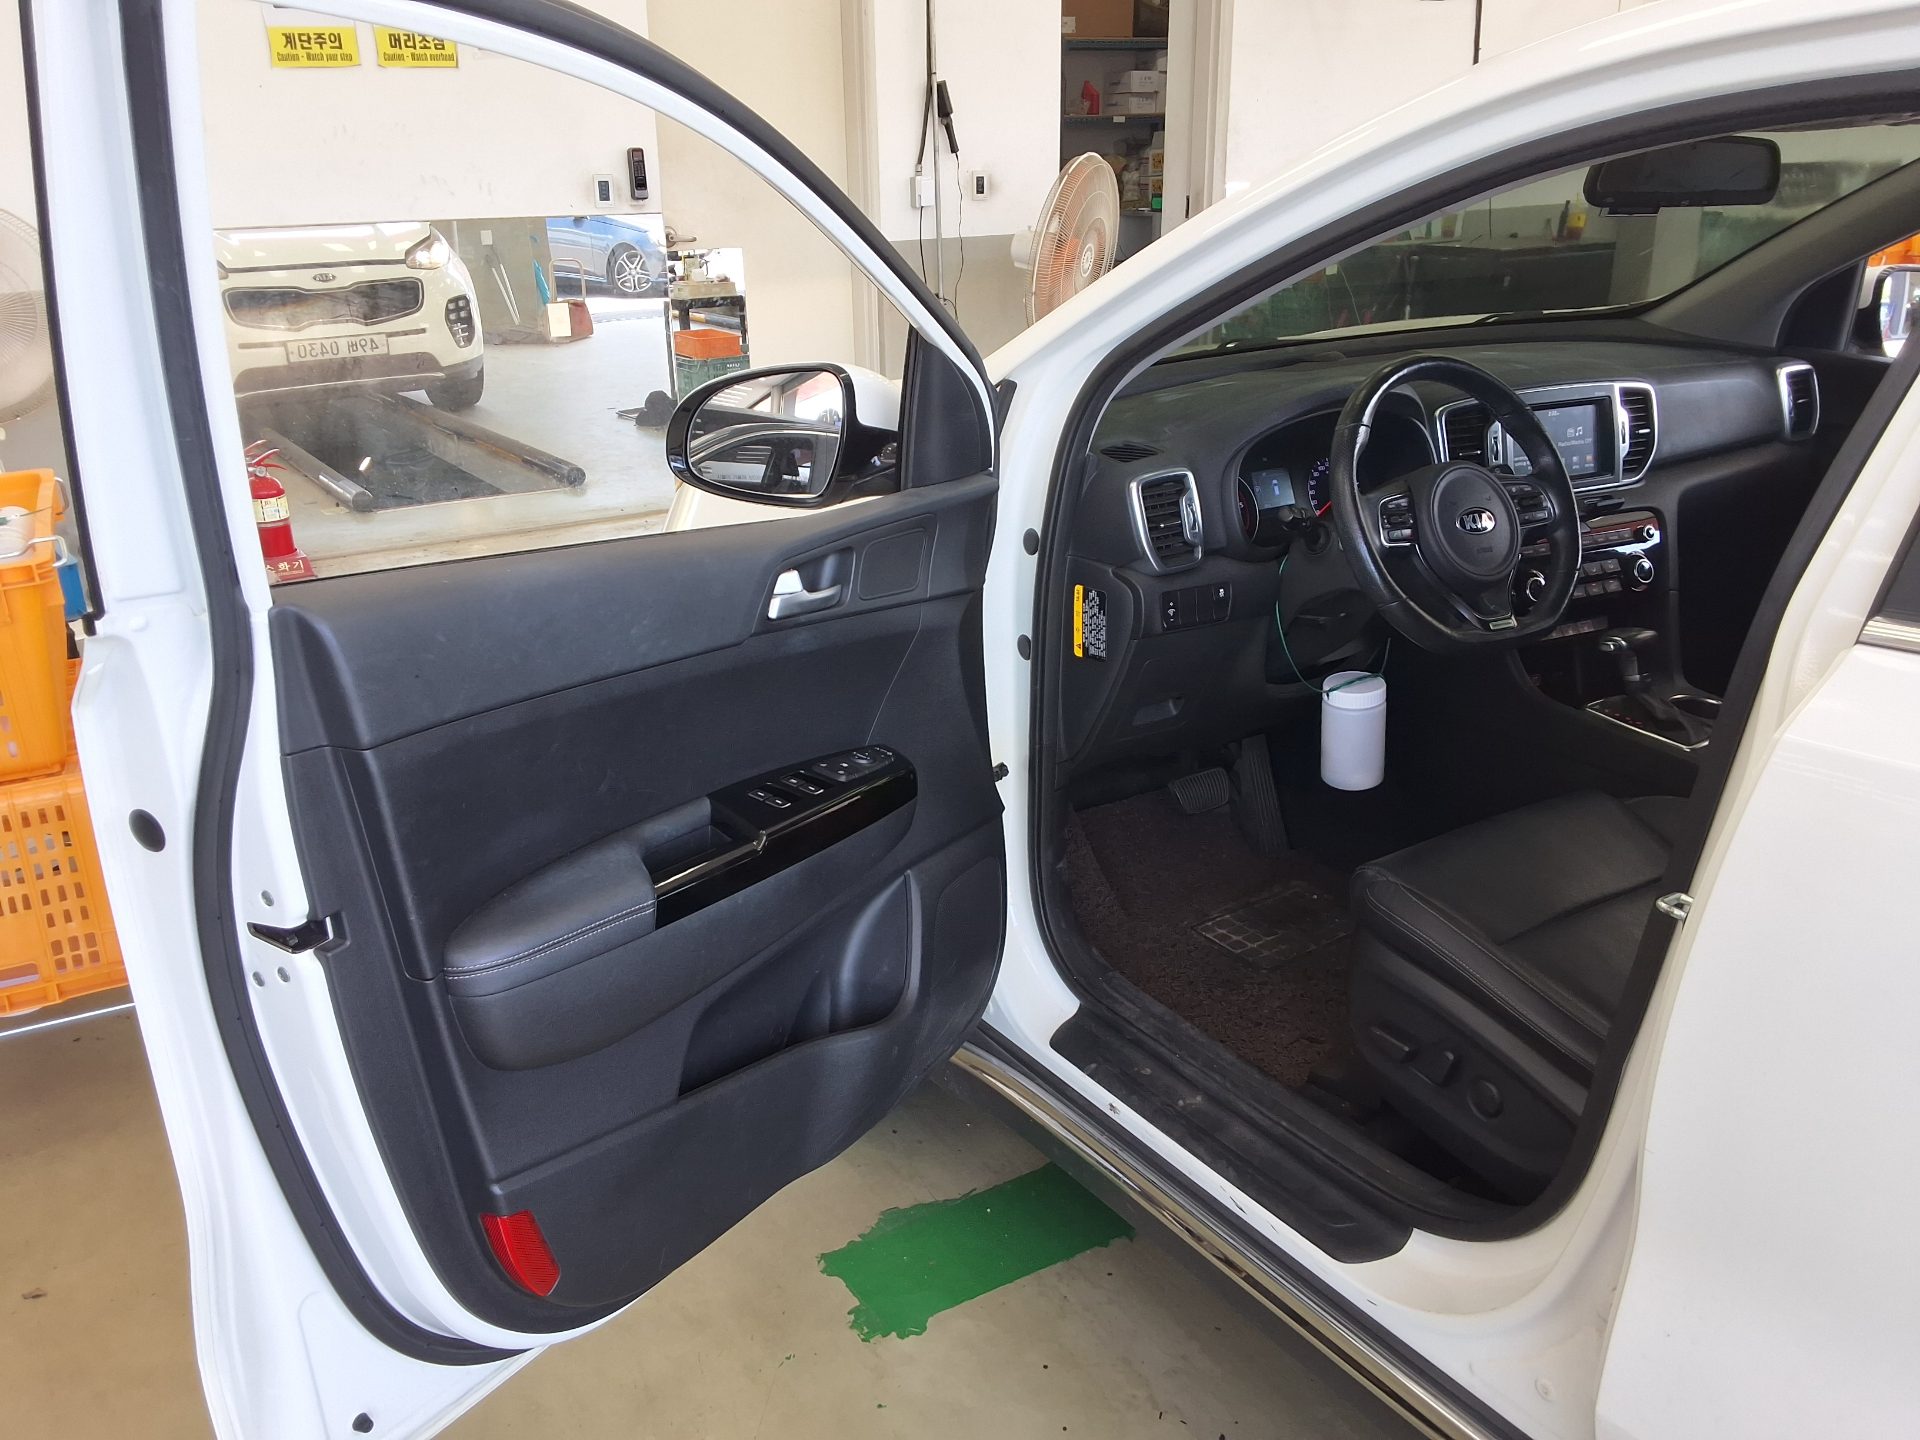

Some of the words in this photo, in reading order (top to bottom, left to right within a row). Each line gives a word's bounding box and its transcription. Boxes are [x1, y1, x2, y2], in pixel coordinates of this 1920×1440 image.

[281, 32, 343, 50] 계단주의
[388, 33, 446, 50] 머리조심
[276, 51, 300, 62] Caution
[305, 51, 325, 62] Watch
[325, 53, 339, 62] your
[339, 51, 353, 62] step
[383, 51, 406, 62] Caution
[410, 51, 429, 62] Watch
[429, 51, 455, 62] overhead
[1462, 513, 1493, 530] KIA
